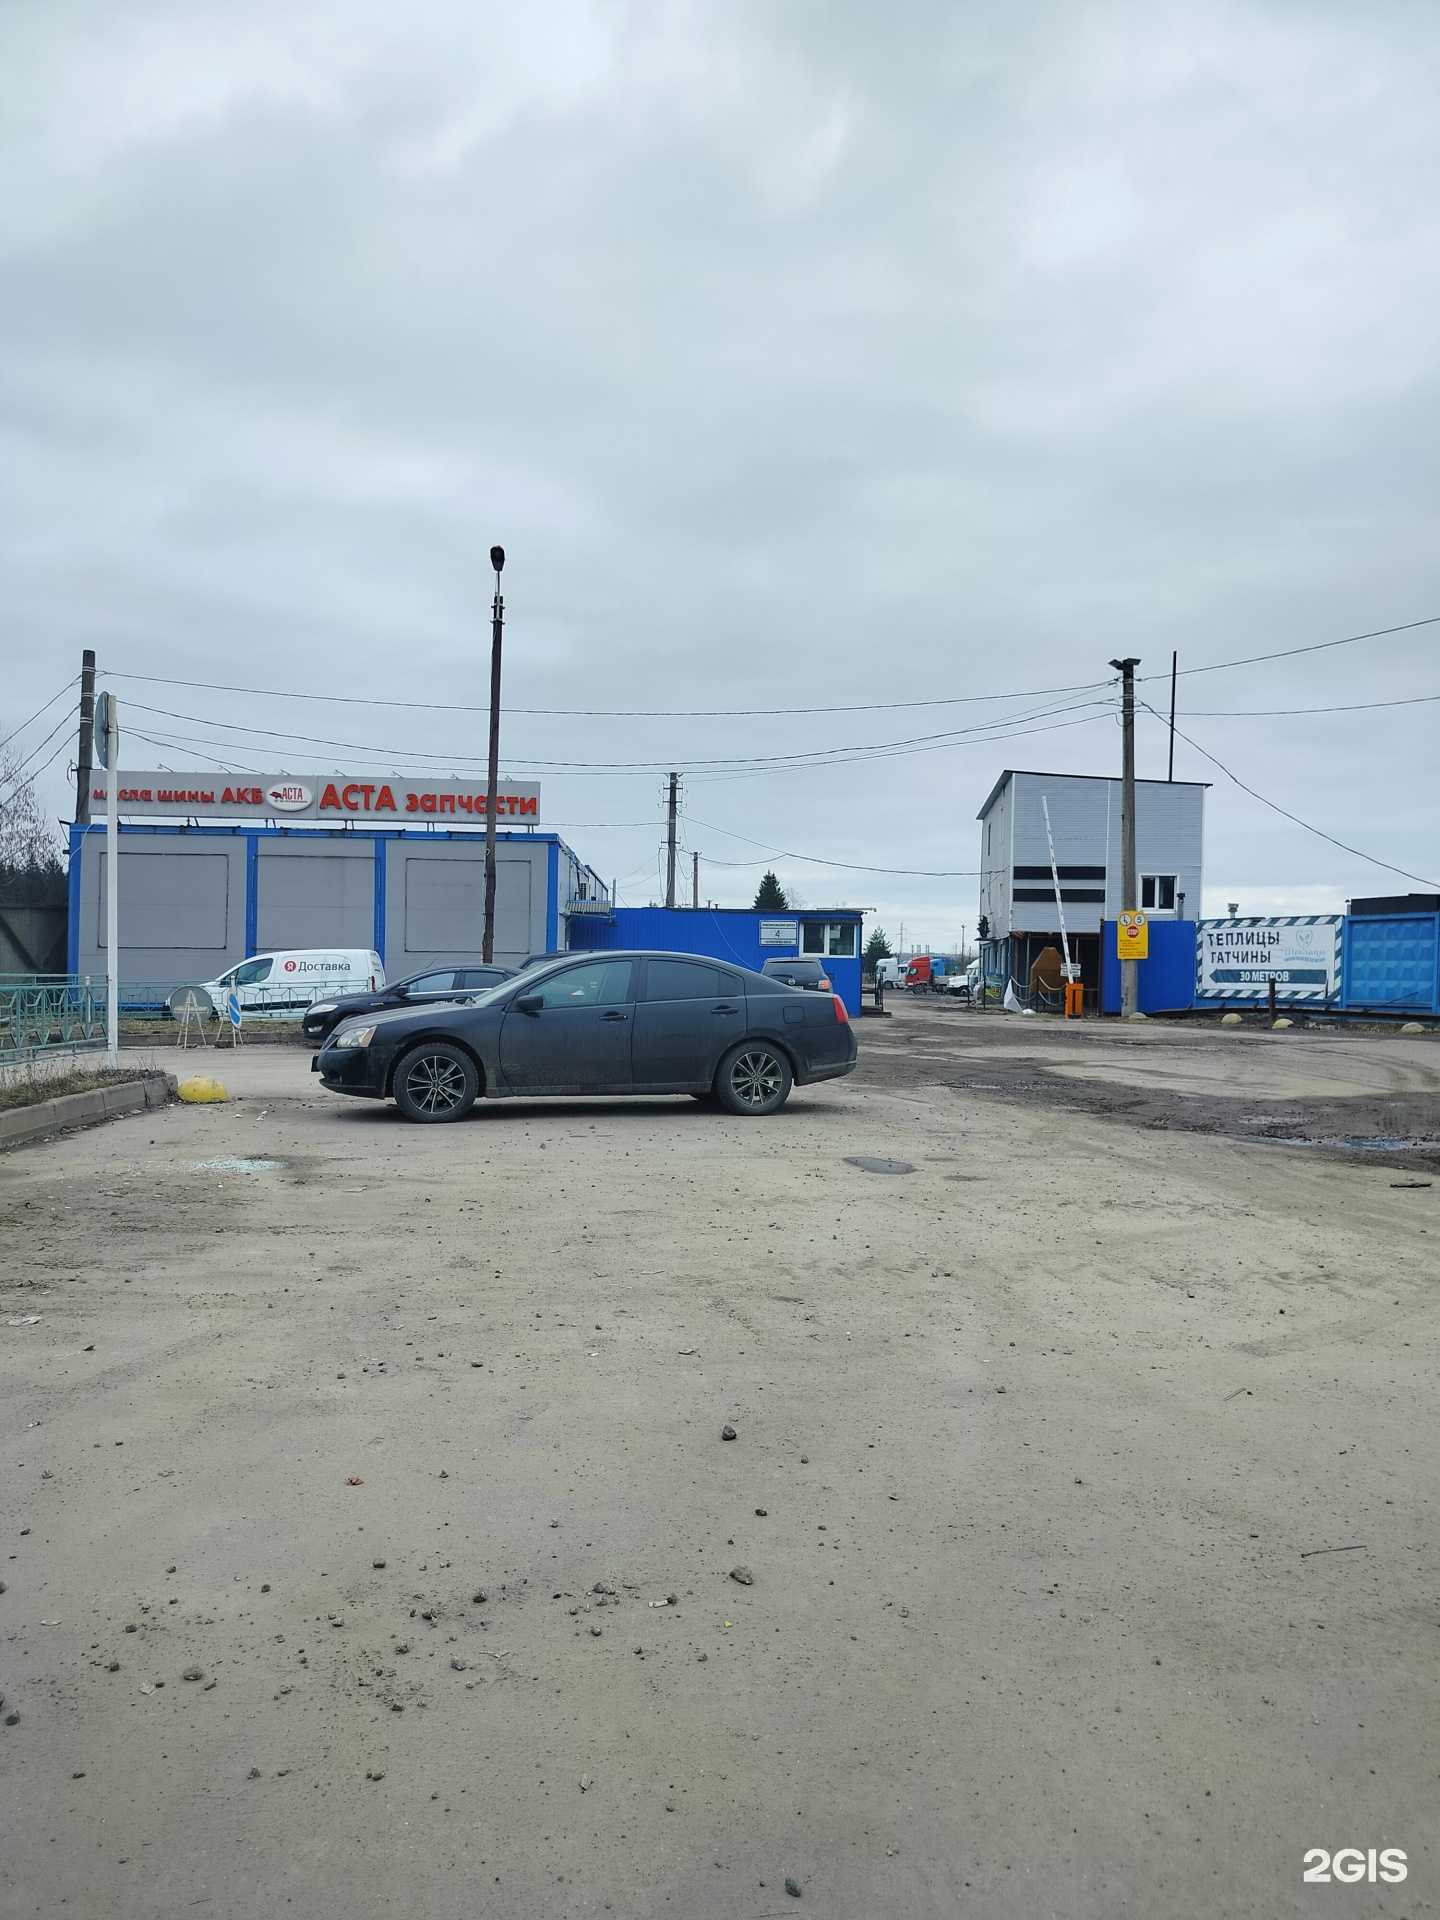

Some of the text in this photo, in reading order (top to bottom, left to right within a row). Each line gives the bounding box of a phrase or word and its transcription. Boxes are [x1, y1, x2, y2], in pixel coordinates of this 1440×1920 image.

[93, 787, 264, 805] мсла шины АКБ
[282, 787, 303, 800] АСТА
[319, 784, 397, 811] АСТА
[1207, 931, 1280, 947] ТЕПЛИЦЫ
[1211, 951, 1271, 963] ГАТЧИНЫ
[298, 961, 351, 972] Доставка
[1240, 971, 1289, 982] 30 МЕТРОВ
